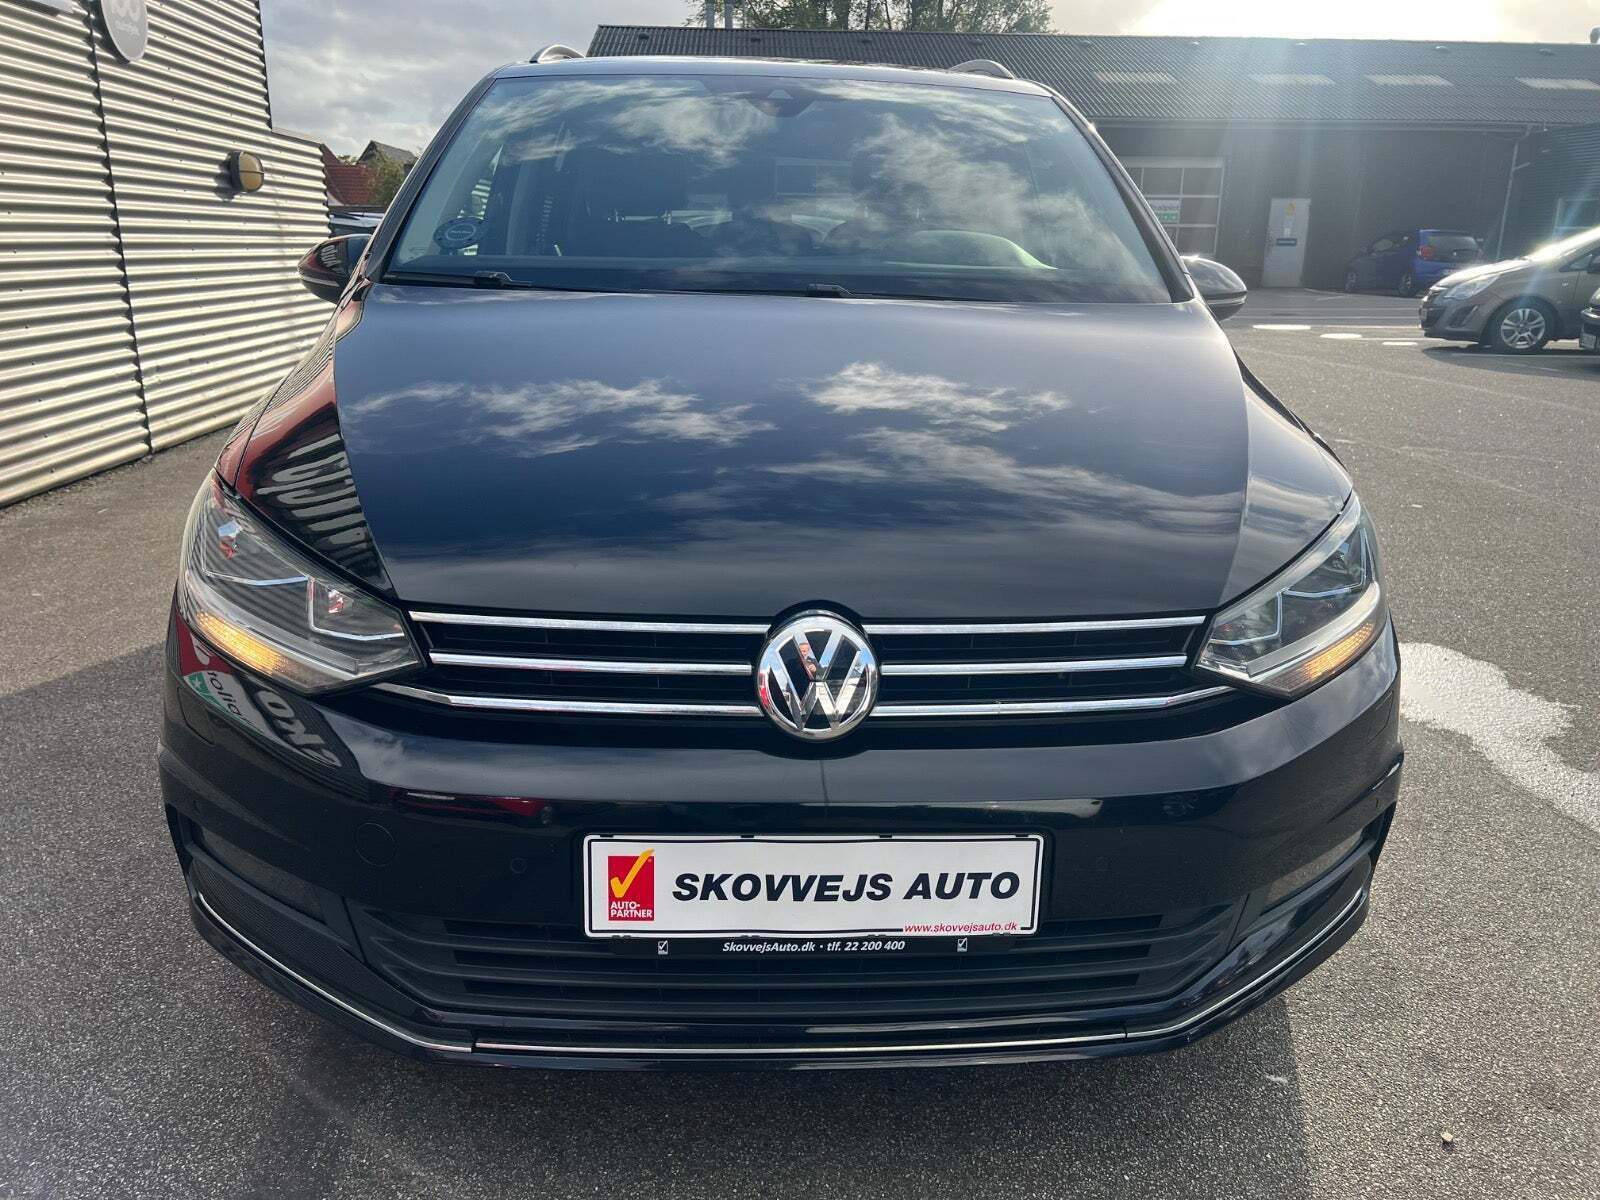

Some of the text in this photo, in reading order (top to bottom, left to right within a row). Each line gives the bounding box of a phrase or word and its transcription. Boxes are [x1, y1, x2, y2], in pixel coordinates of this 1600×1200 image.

[672, 871, 1020, 902] SKOVVEJS AUTO
[610, 901, 641, 910] AUTO-
[610, 909, 653, 918] PARTNER
[904, 921, 1018, 934] www.skovvejsauto.dk
[722, 940, 906, 954] SkovvejsAuto.dk tlf. 22 200 400
